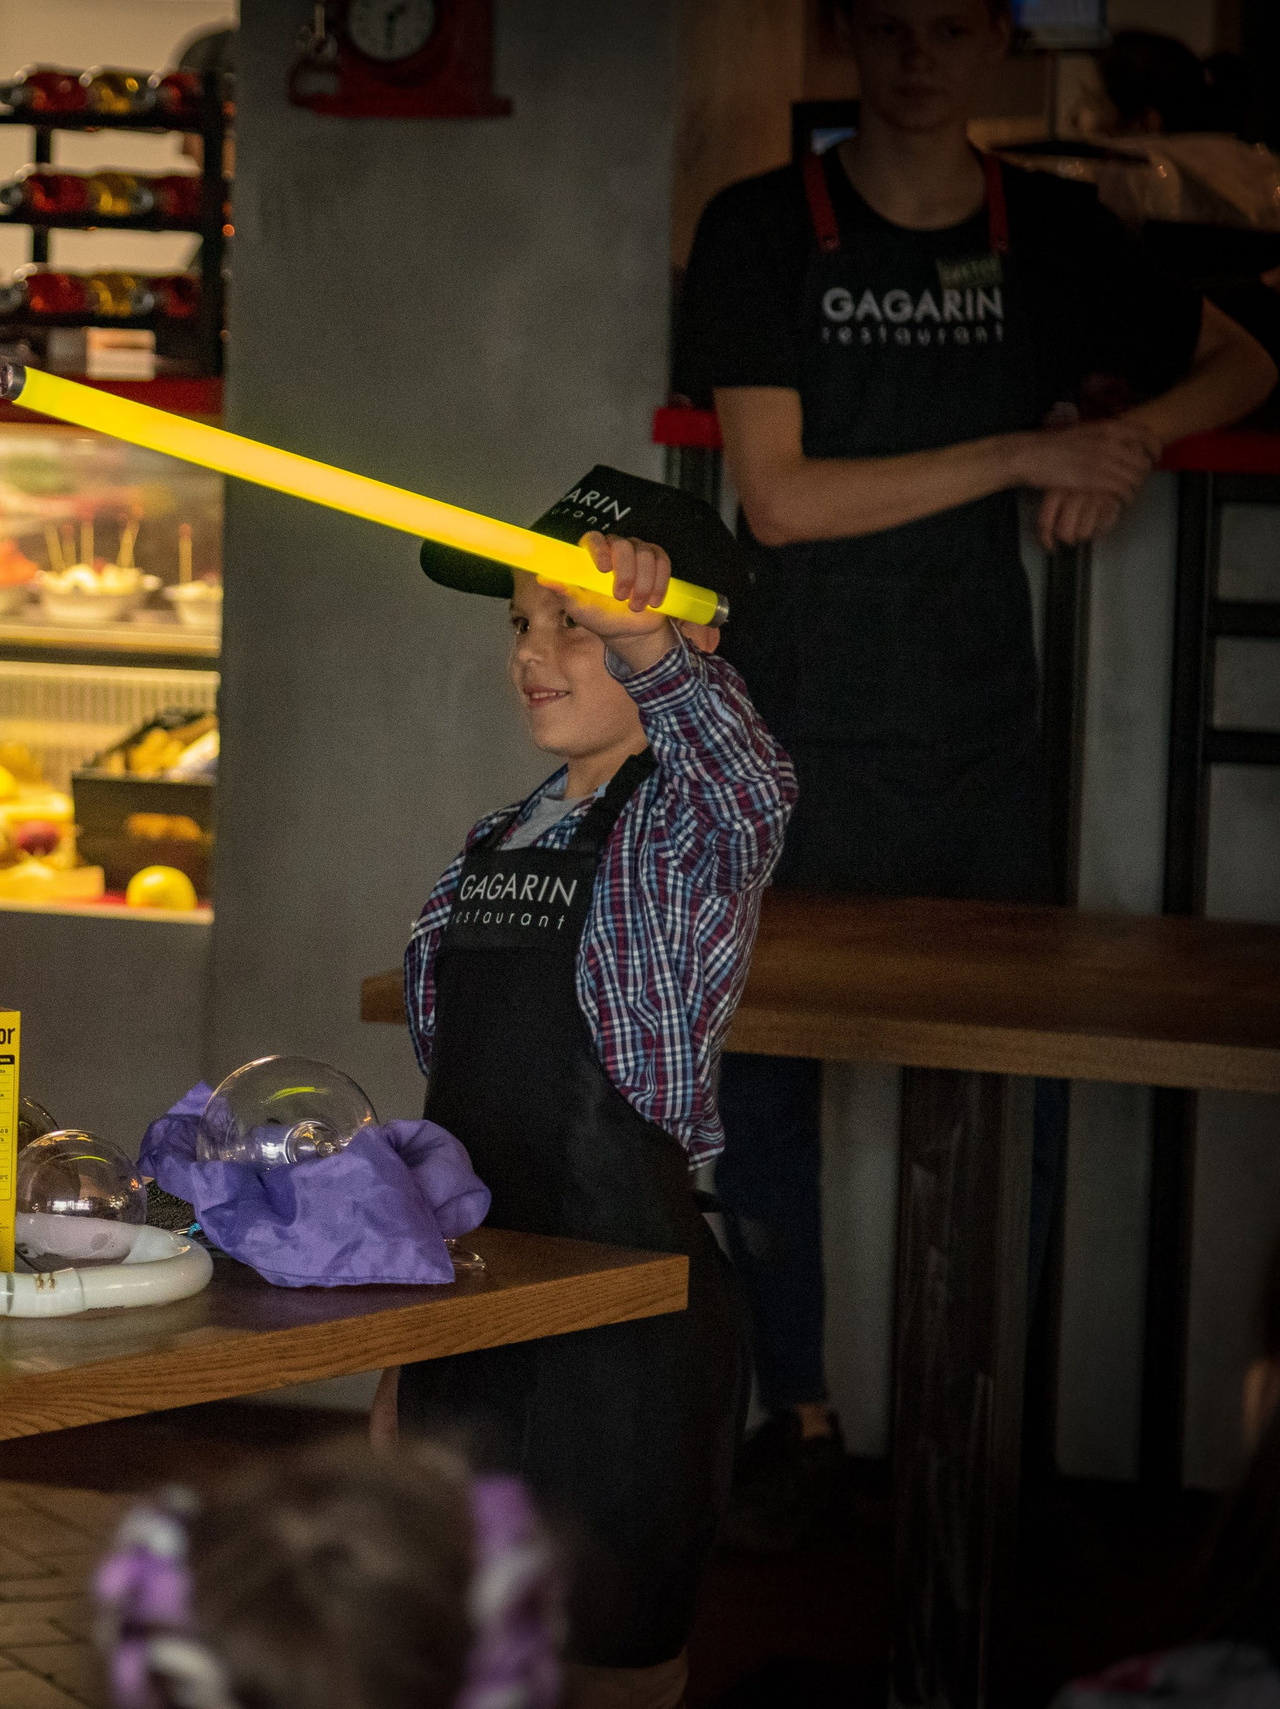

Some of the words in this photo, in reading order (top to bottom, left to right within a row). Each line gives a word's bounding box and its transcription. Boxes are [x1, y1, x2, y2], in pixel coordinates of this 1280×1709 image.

[822, 286, 1004, 323] GAGARIN
[822, 322, 1003, 346] restaurant
[563, 487, 632, 522] ARIN
[460, 872, 577, 907] GAGARIN
[451, 908, 565, 930] restaurant
